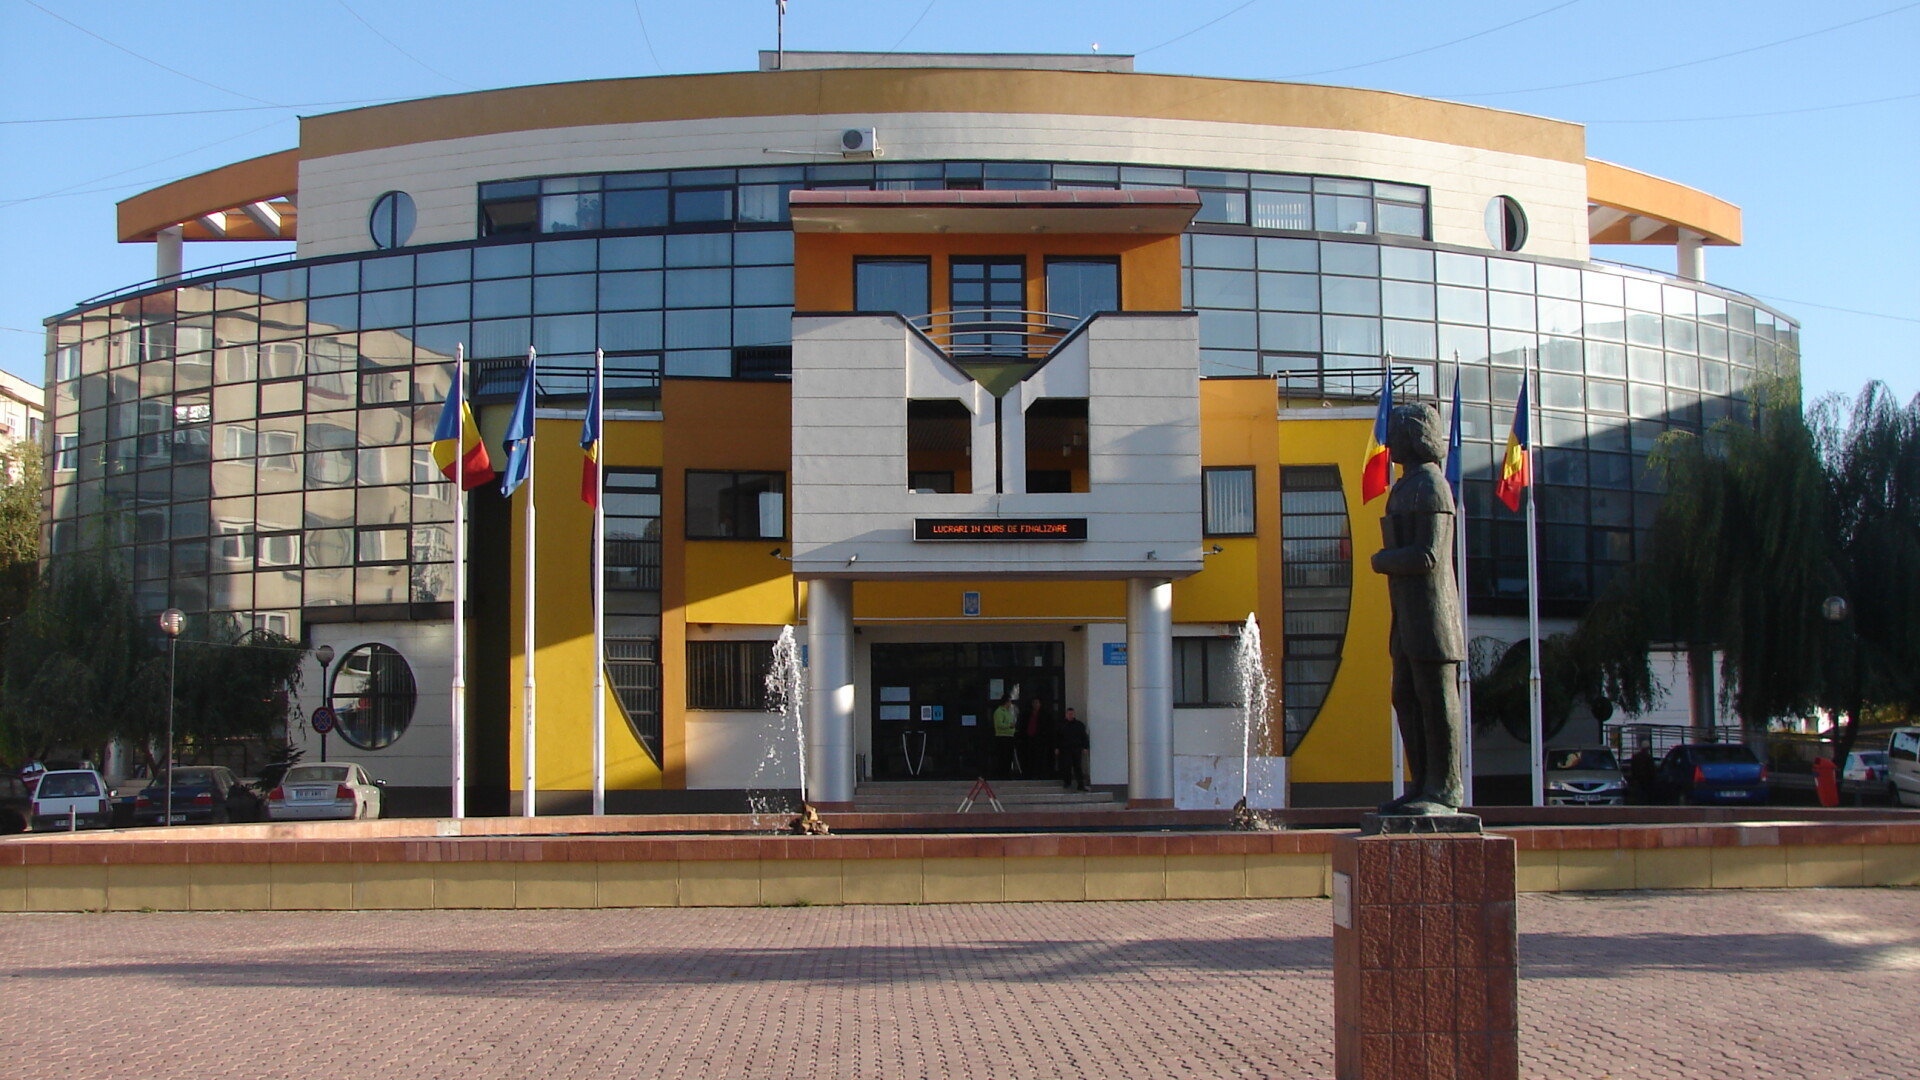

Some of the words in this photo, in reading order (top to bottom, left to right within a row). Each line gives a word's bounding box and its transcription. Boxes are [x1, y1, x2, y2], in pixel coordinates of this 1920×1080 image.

[933, 525, 968, 533] LUCRARI
[971, 525, 980, 533] IN
[983, 525, 1004, 533] CURS
[1007, 525, 1018, 533] DE
[1020, 524, 1068, 533] FINALIZARE
